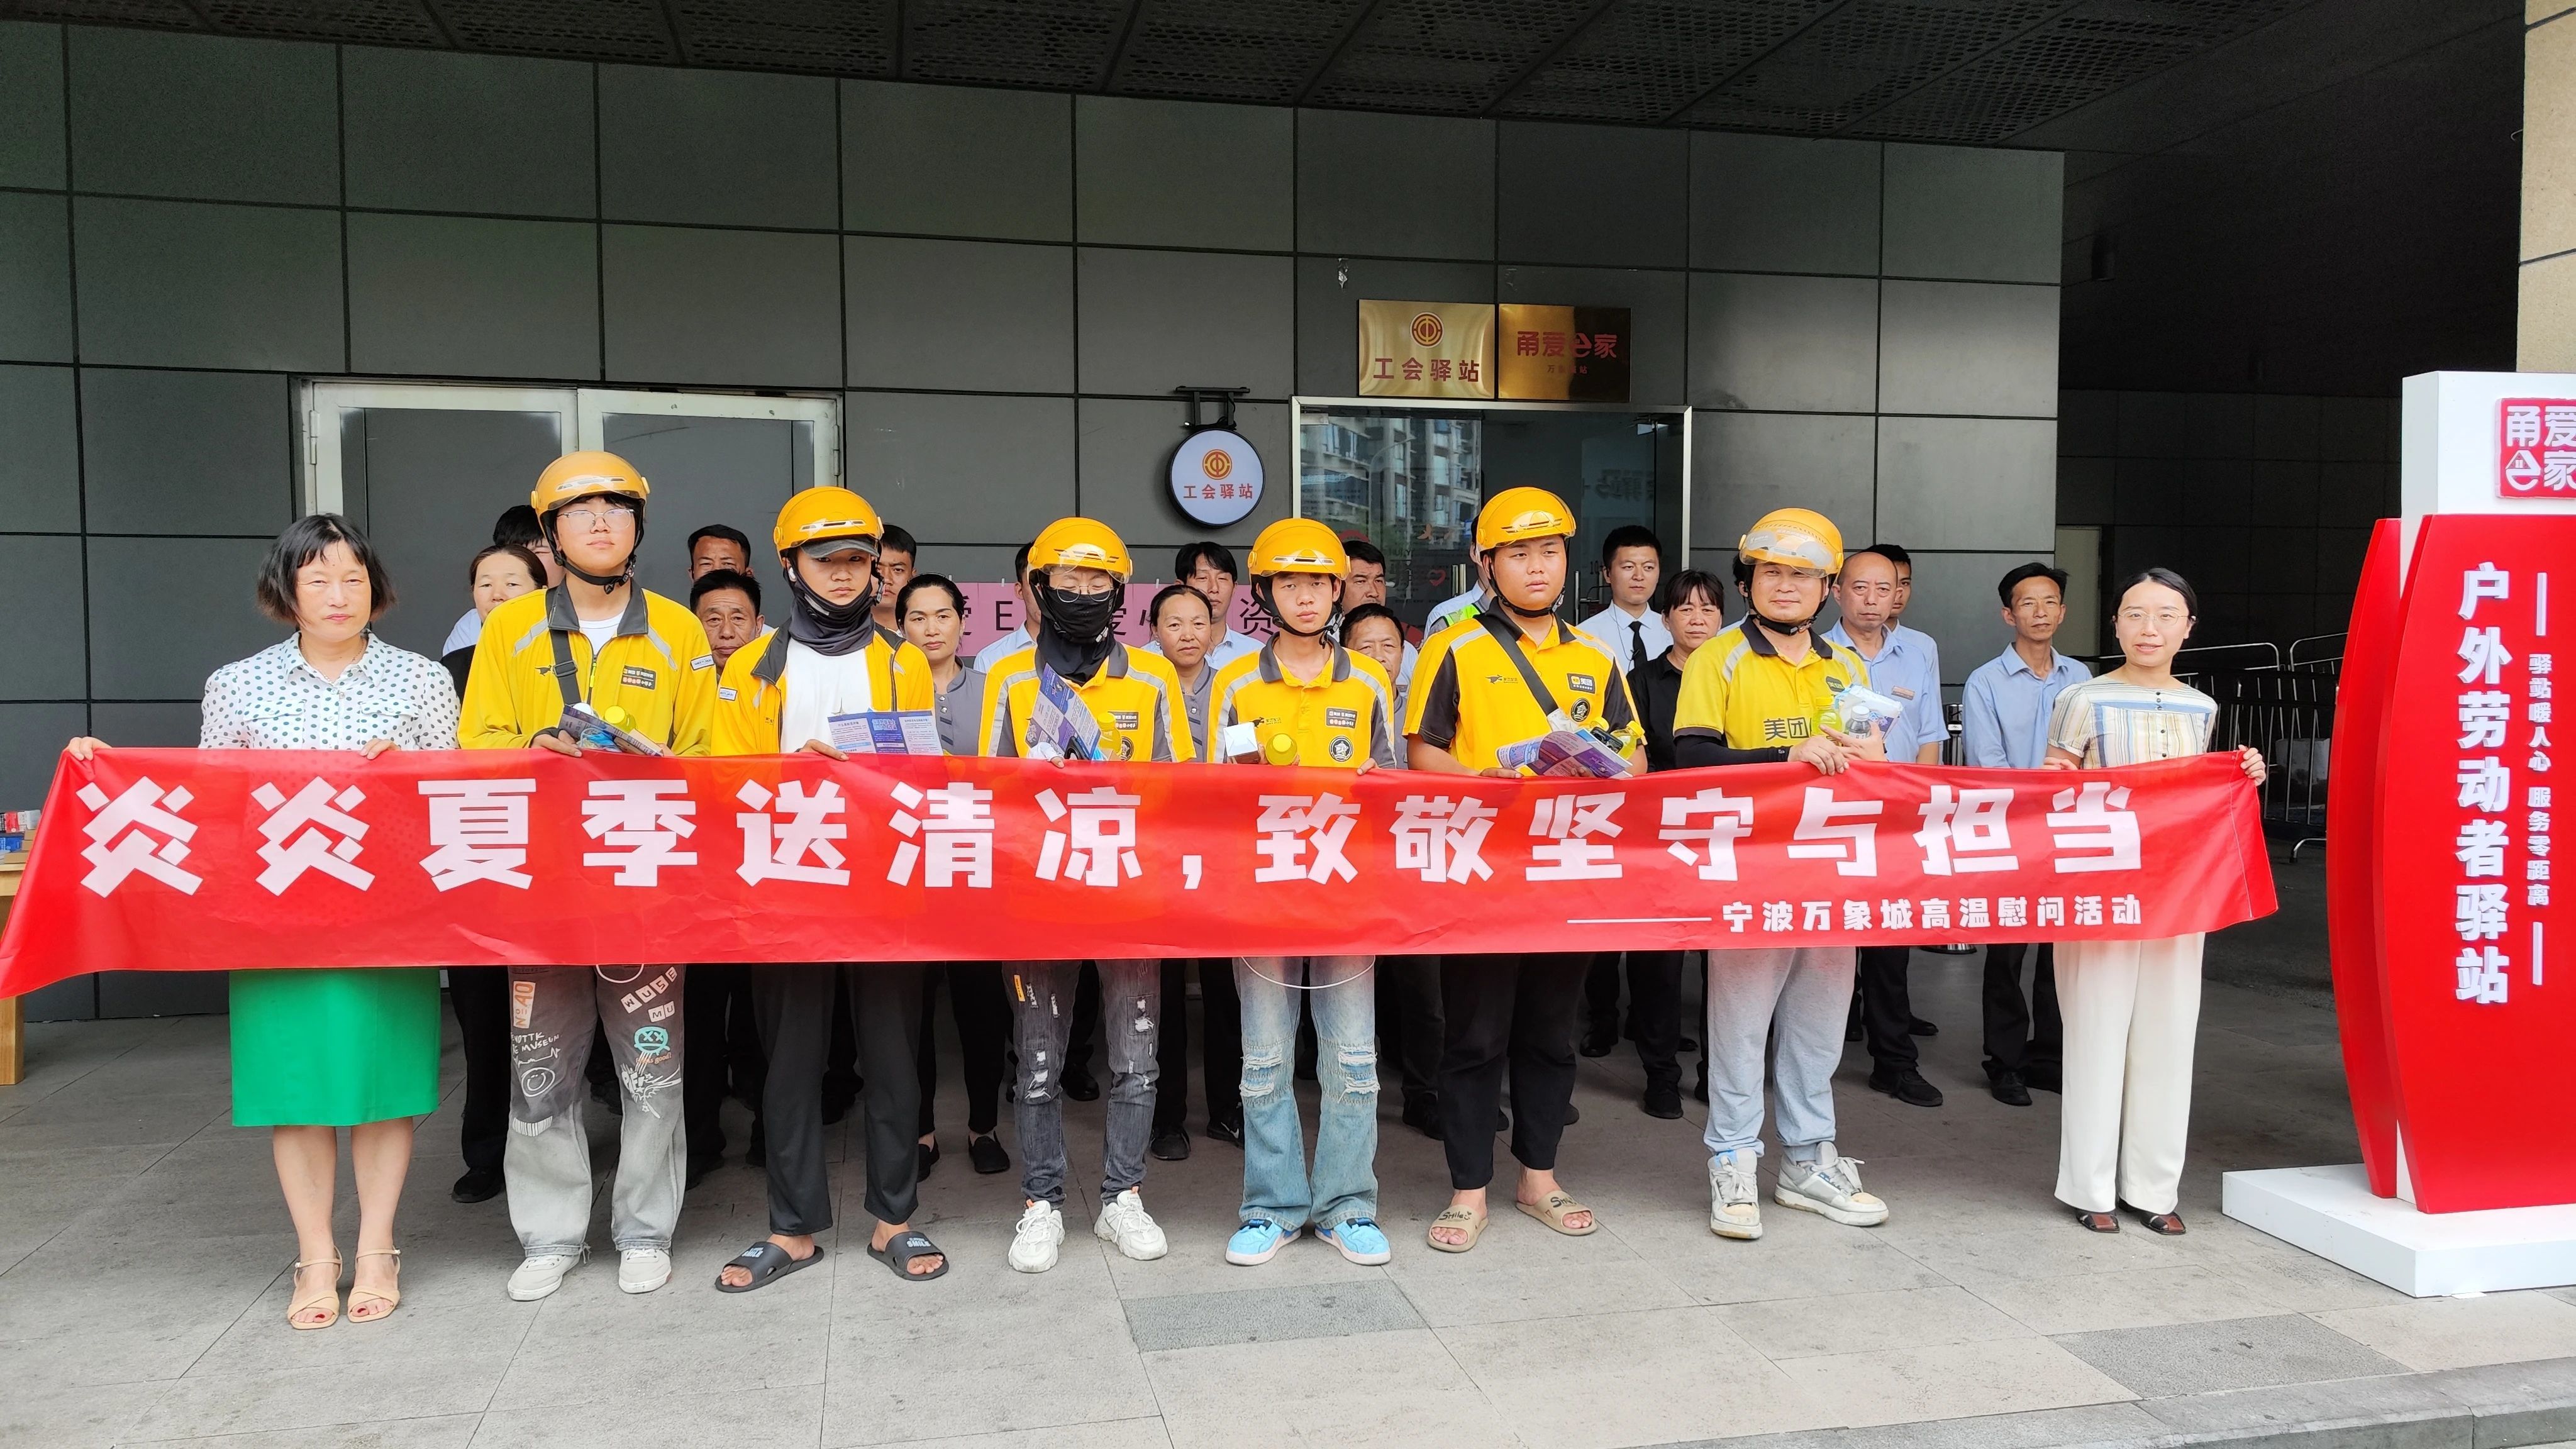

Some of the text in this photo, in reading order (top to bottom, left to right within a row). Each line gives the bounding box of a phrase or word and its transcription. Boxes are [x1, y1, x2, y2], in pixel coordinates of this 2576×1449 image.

[1373, 357, 1480, 383] 工会驿站
[2506, 406, 2576, 447] 甬爱
[1183, 483, 1253, 500] 工会驿站
[1763, 717, 1812, 741] 美团
[2455, 562, 2513, 1005] 户外劳动者驿站
[2526, 653, 2552, 906] 驿站暖人心 服务零距离
